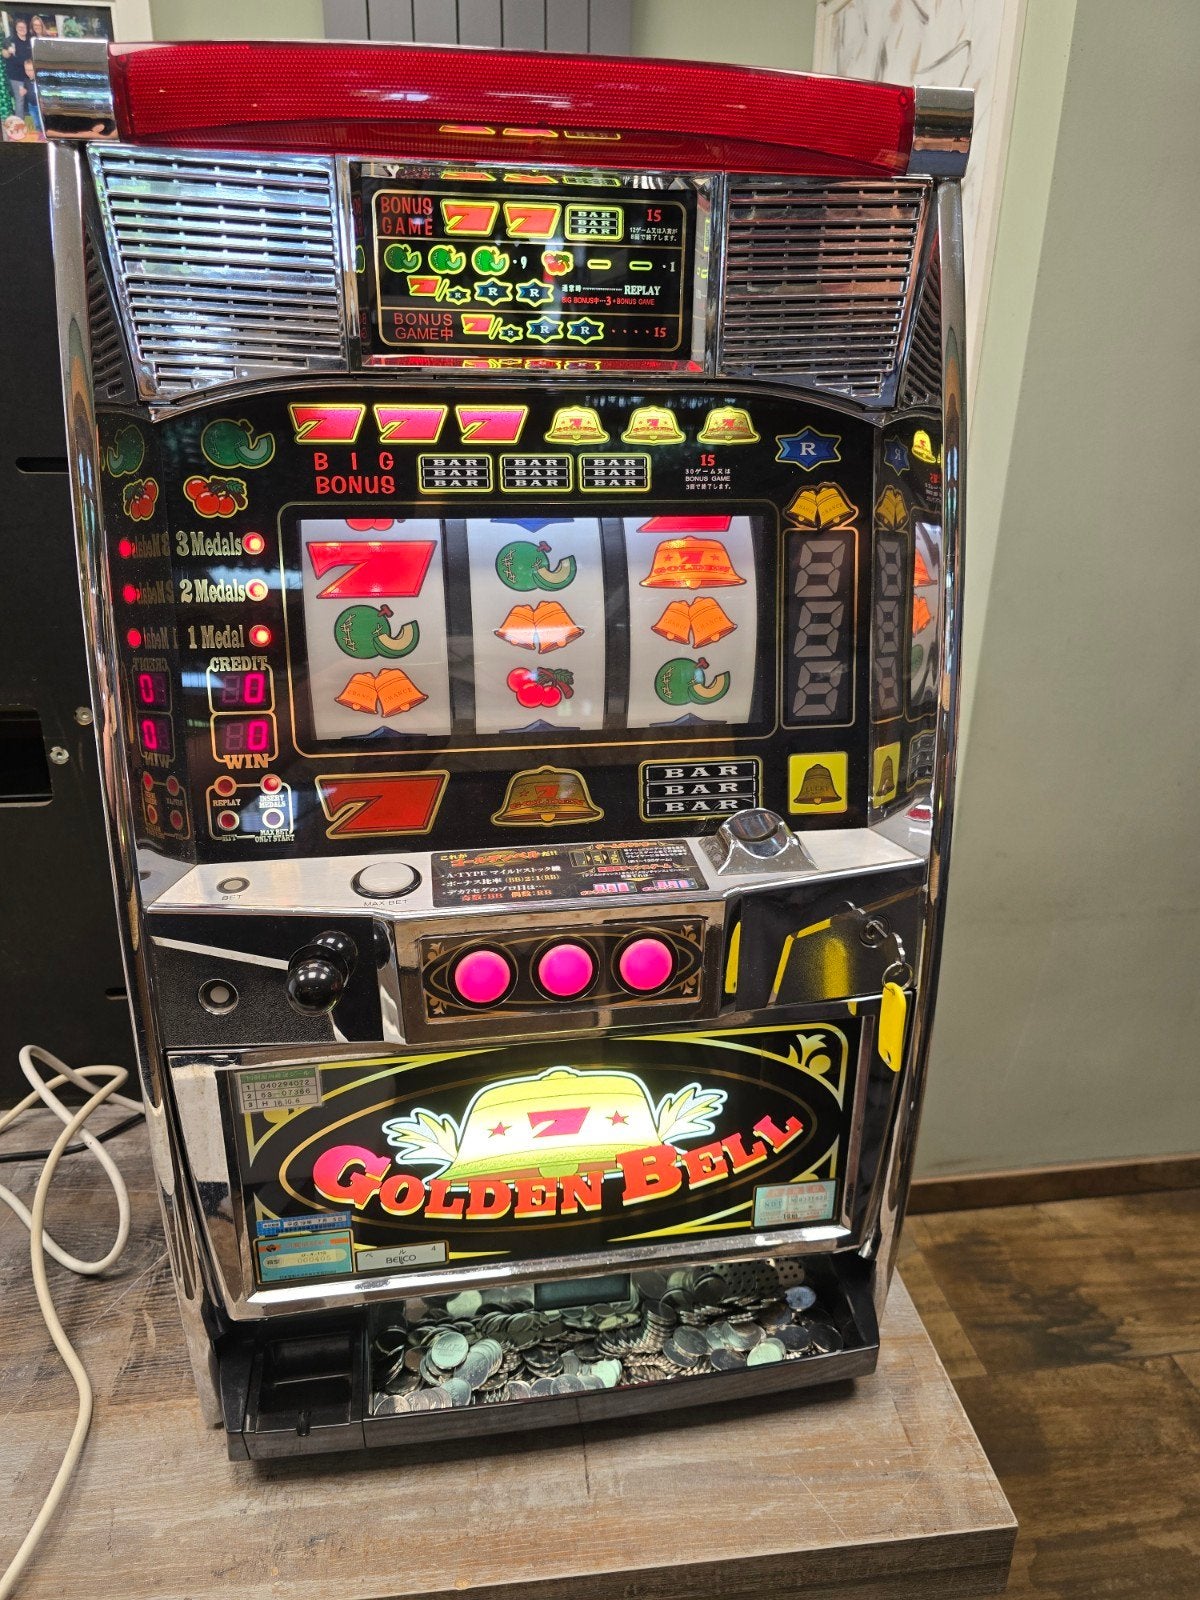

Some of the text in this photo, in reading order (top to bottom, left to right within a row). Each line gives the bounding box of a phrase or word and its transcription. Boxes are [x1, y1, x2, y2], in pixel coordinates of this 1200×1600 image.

[381, 196, 433, 215] BONUS
[647, 209, 662, 222] 15
[382, 216, 433, 236] GAME
[669, 261, 676, 273] 1
[488, 287, 498, 296] R
[529, 288, 540, 297] R
[624, 284, 661, 296] REPLAY
[393, 312, 453, 327] BONUS
[394, 327, 454, 341] GAME中
[540, 325, 550, 334] R
[580, 327, 590, 335] R
[654, 327, 667, 338] 15
[799, 442, 817, 456] R
[314, 452, 395, 471] BIG
[700, 454, 715, 467] 15
[315, 475, 396, 495] BONUS
[176, 530, 242, 557] 3 Medals
[179, 578, 246, 604] 2 Medals
[188, 624, 245, 650] 1 Medal
[209, 655, 268, 673] CREDIT
[244, 673, 265, 704] 0
[247, 719, 269, 750] 0
[222, 753, 270, 770] WIN
[664, 765, 739, 779] BAR
[664, 782, 739, 796] BAR
[212, 798, 242, 807] REPLAY
[258, 794, 285, 802] INSERT
[258, 800, 286, 809] MEDALS
[665, 799, 739, 813] BAR
[254, 833, 295, 843] ONLY START
[259, 828, 275, 836] MAX
[388, 898, 408, 906] BET
[312, 1114, 804, 1220] GOLDEN BELL
